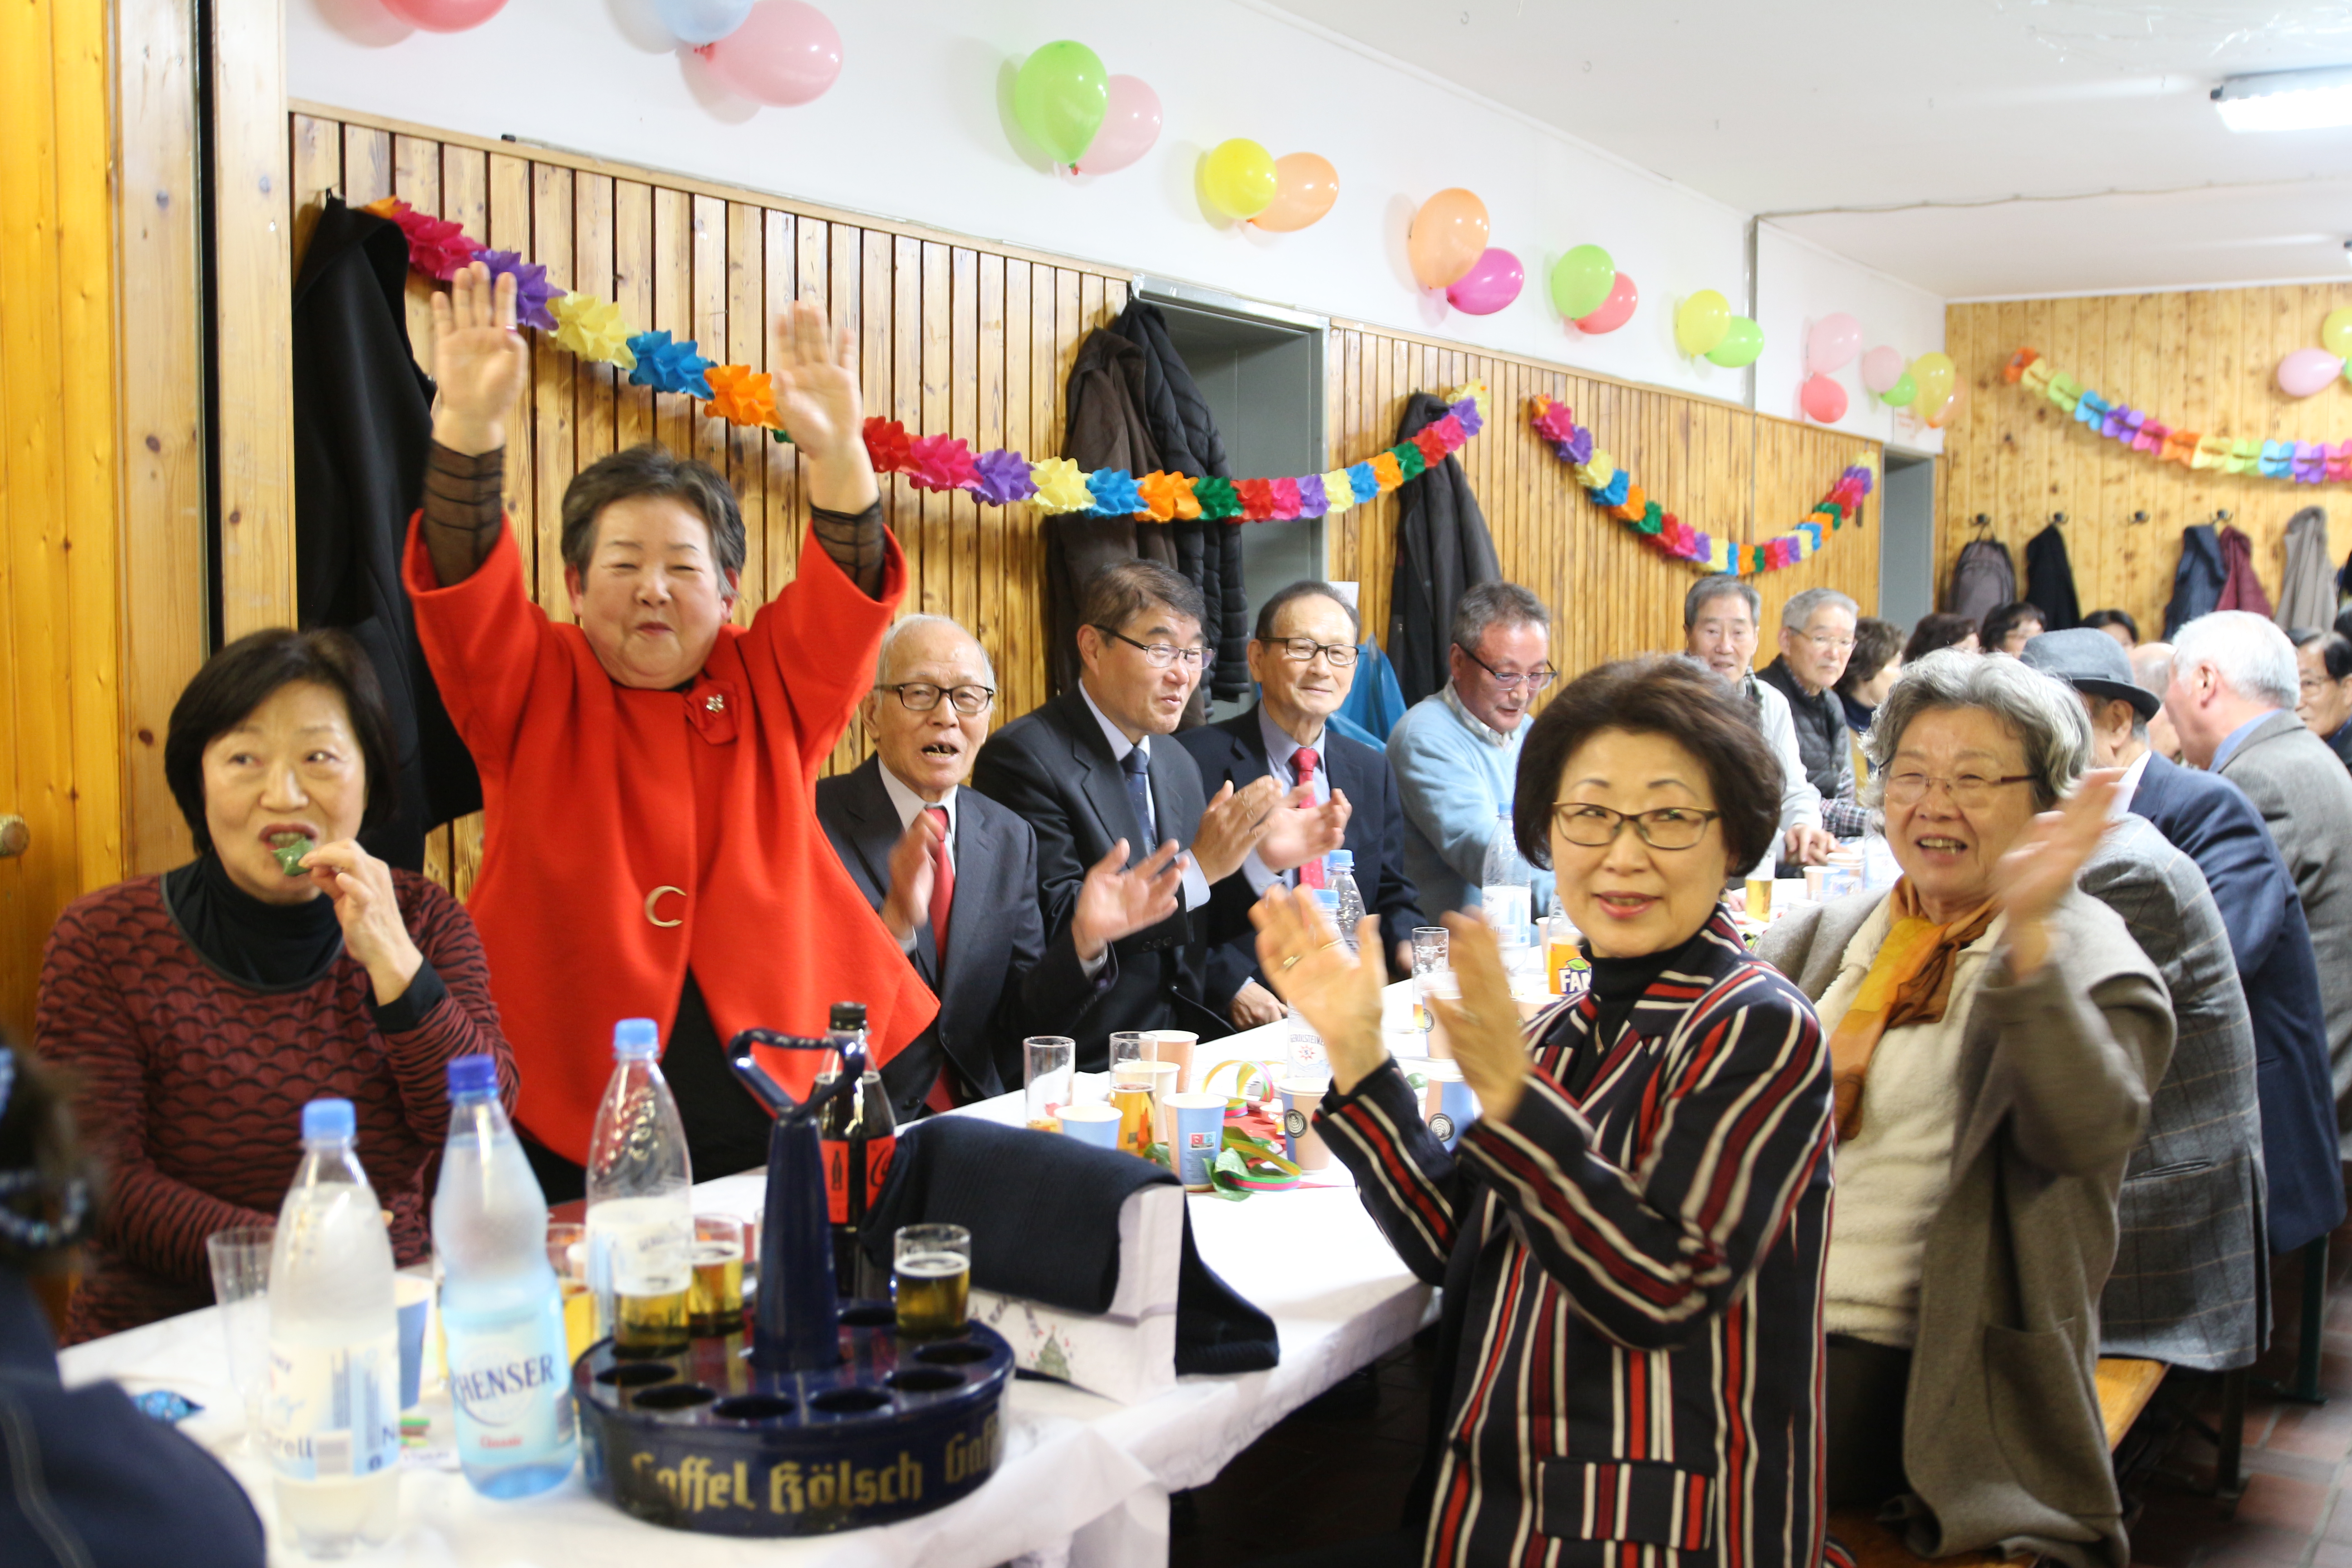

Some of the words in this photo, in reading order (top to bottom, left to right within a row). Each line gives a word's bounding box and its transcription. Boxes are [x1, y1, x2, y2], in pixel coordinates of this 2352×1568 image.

[1559, 967, 1592, 992] FAN
[1290, 1034, 1325, 1046] GEROLSTEINE
[769, 1451, 923, 1514] Kölsch
